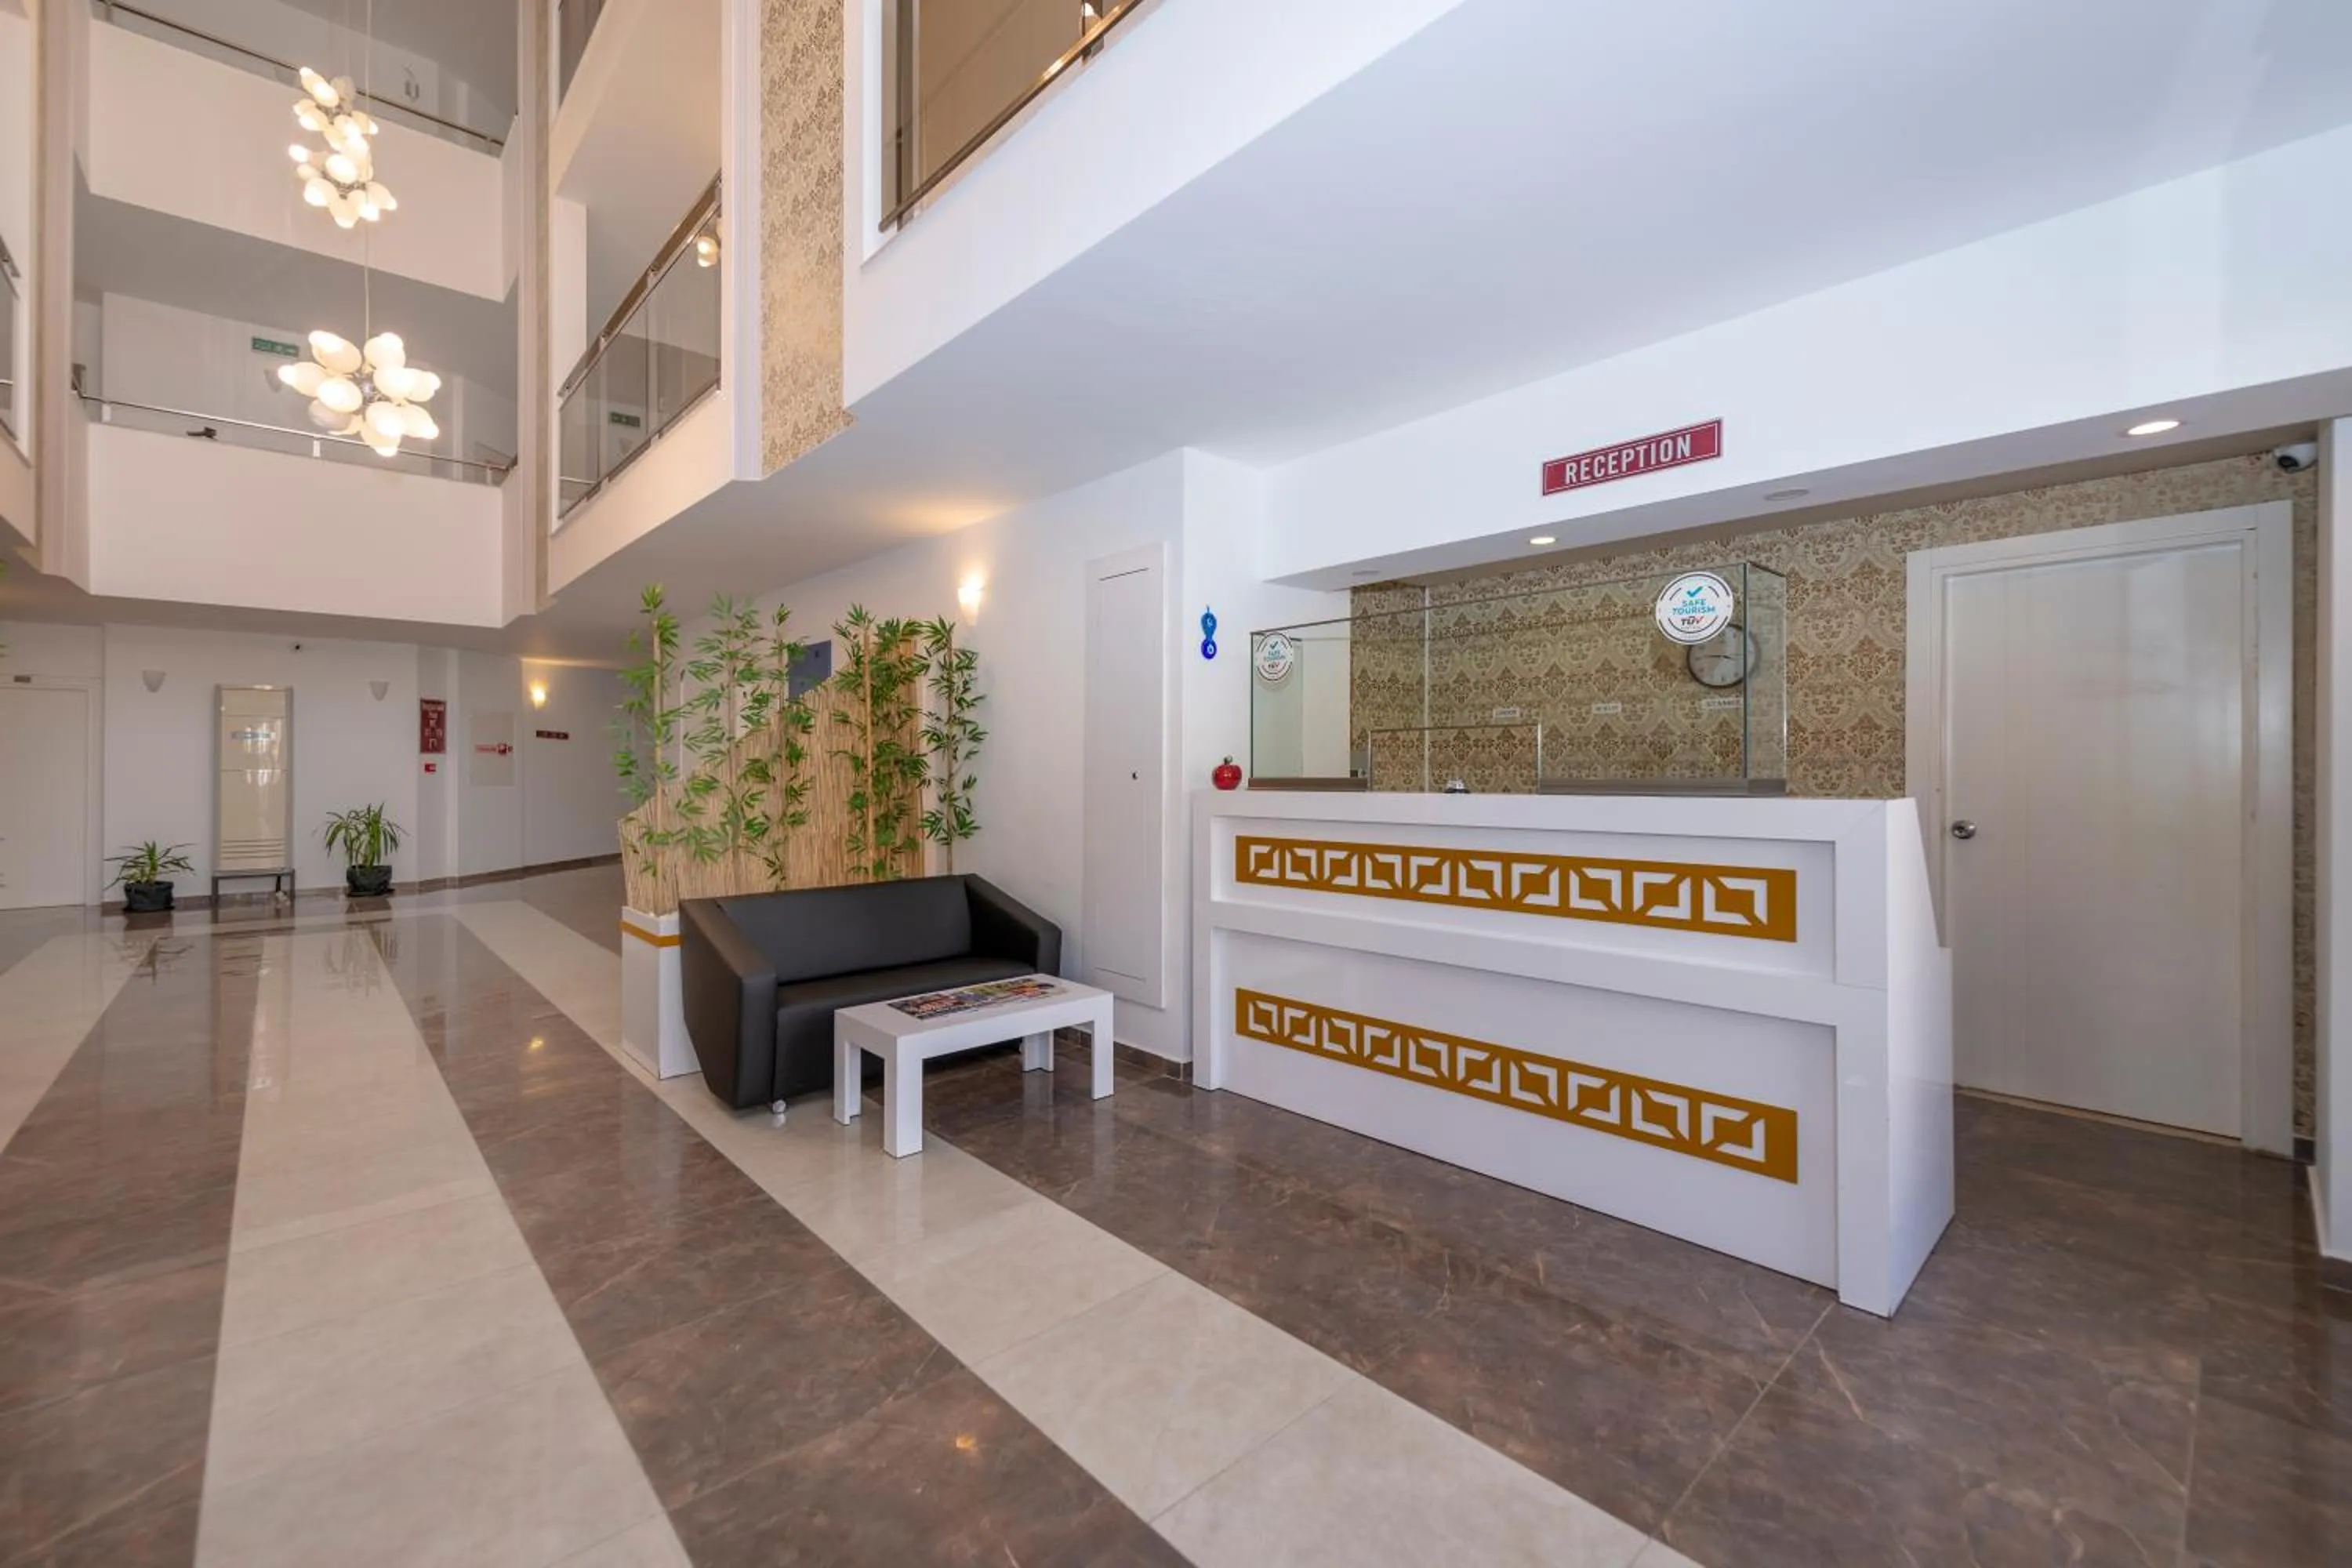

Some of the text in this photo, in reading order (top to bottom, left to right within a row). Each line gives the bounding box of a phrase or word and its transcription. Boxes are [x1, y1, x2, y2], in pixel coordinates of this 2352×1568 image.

[1565, 434, 1692, 485] RECEPTION
[1682, 598, 1707, 608] SAFE
[1672, 605, 1716, 615] TOURISM
